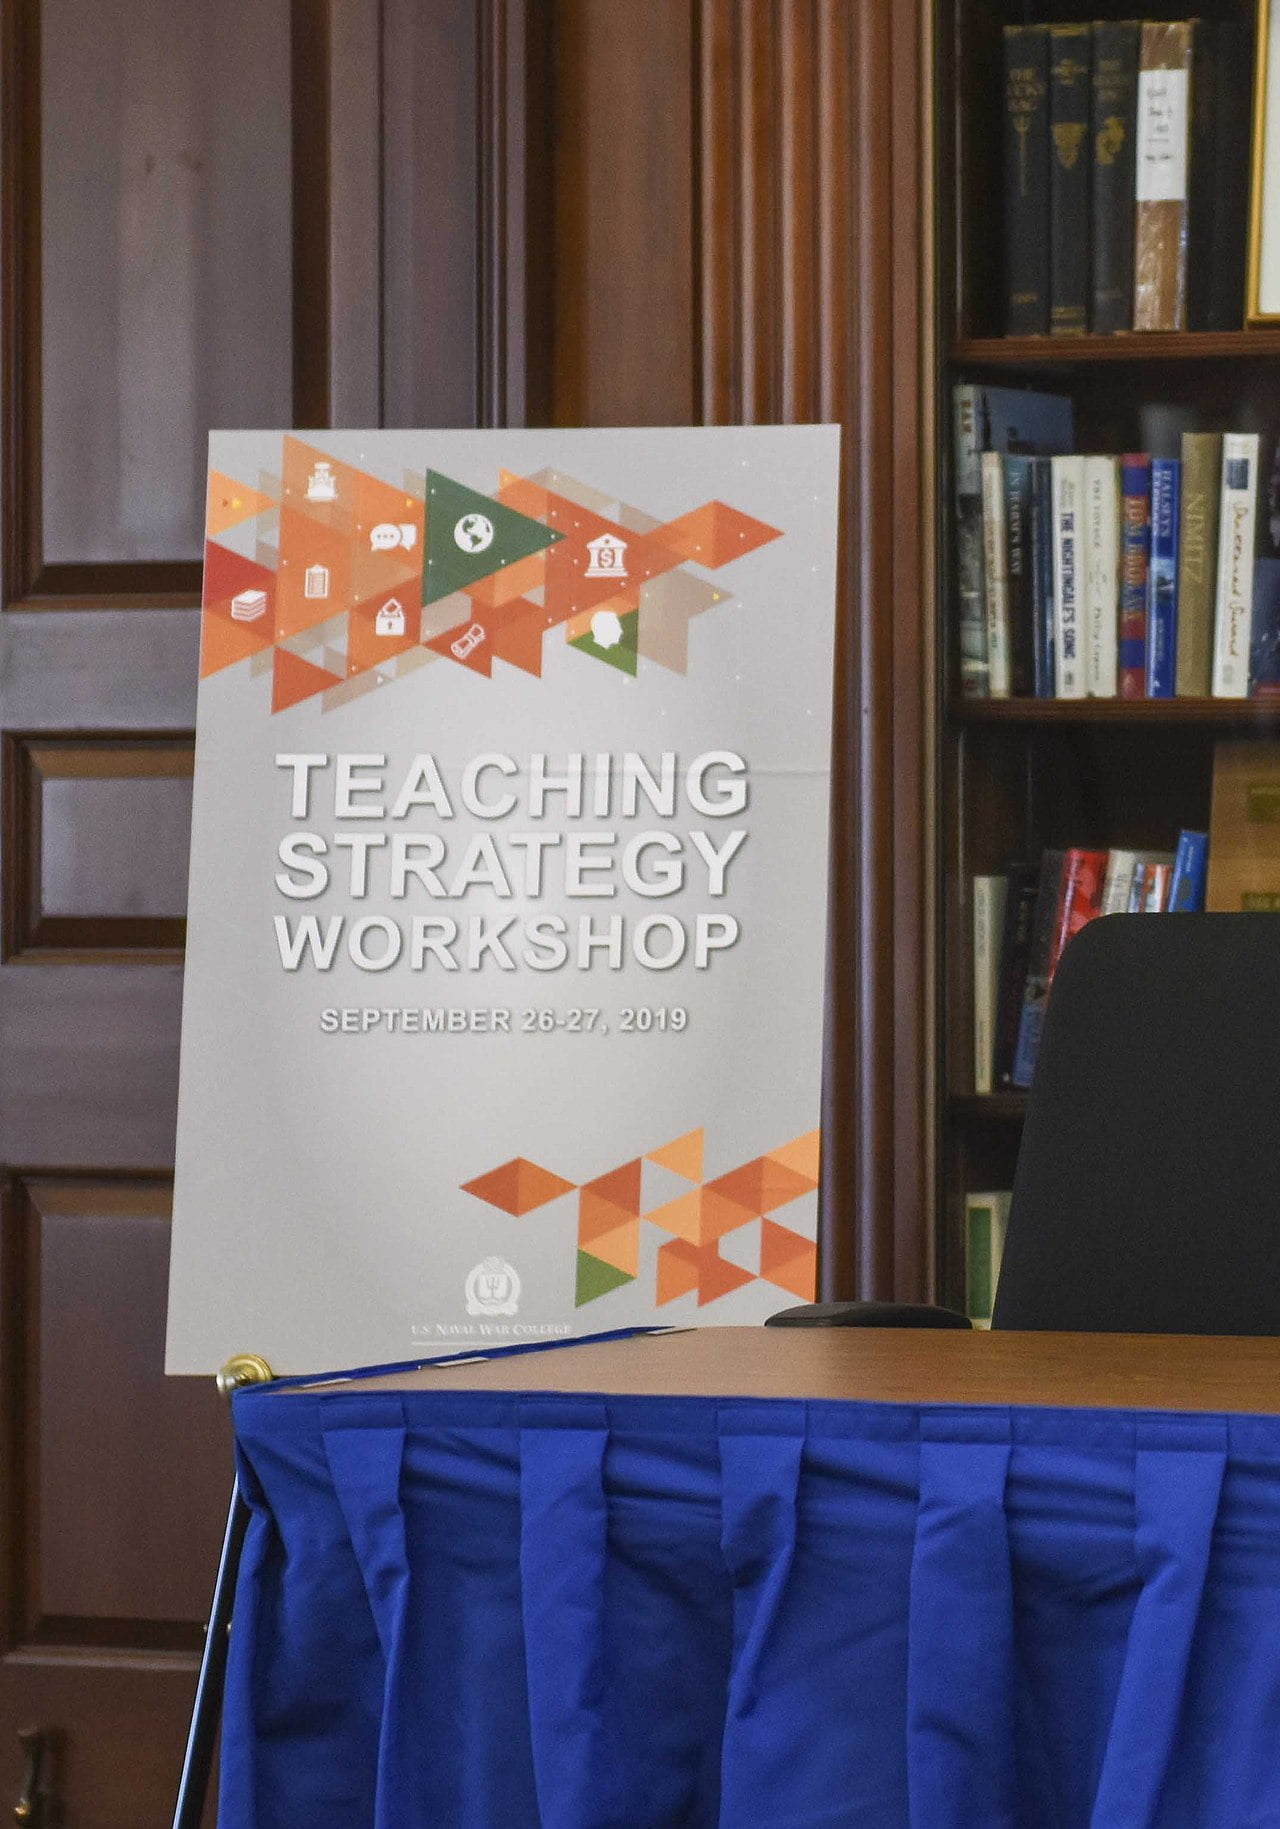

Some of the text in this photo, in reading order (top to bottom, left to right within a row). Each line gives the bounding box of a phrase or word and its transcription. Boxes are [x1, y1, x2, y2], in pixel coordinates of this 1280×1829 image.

[1061, 512, 1074, 532] THE
[1183, 493, 1206, 584] NIMITZ
[1062, 537, 1075, 624] NIGHTINGALE'S
[1063, 627, 1076, 661] SONG
[275, 750, 750, 820] TEACHING
[274, 830, 749, 899] STRATEGY
[273, 912, 740, 972] WORKSHOP
[320, 1007, 689, 1036] SEPTEMBER 26-27, 2019
[436, 1323, 475, 1336] NAVAL
[479, 1323, 509, 1336] WAR
[512, 1323, 572, 1336] COLLEGE
